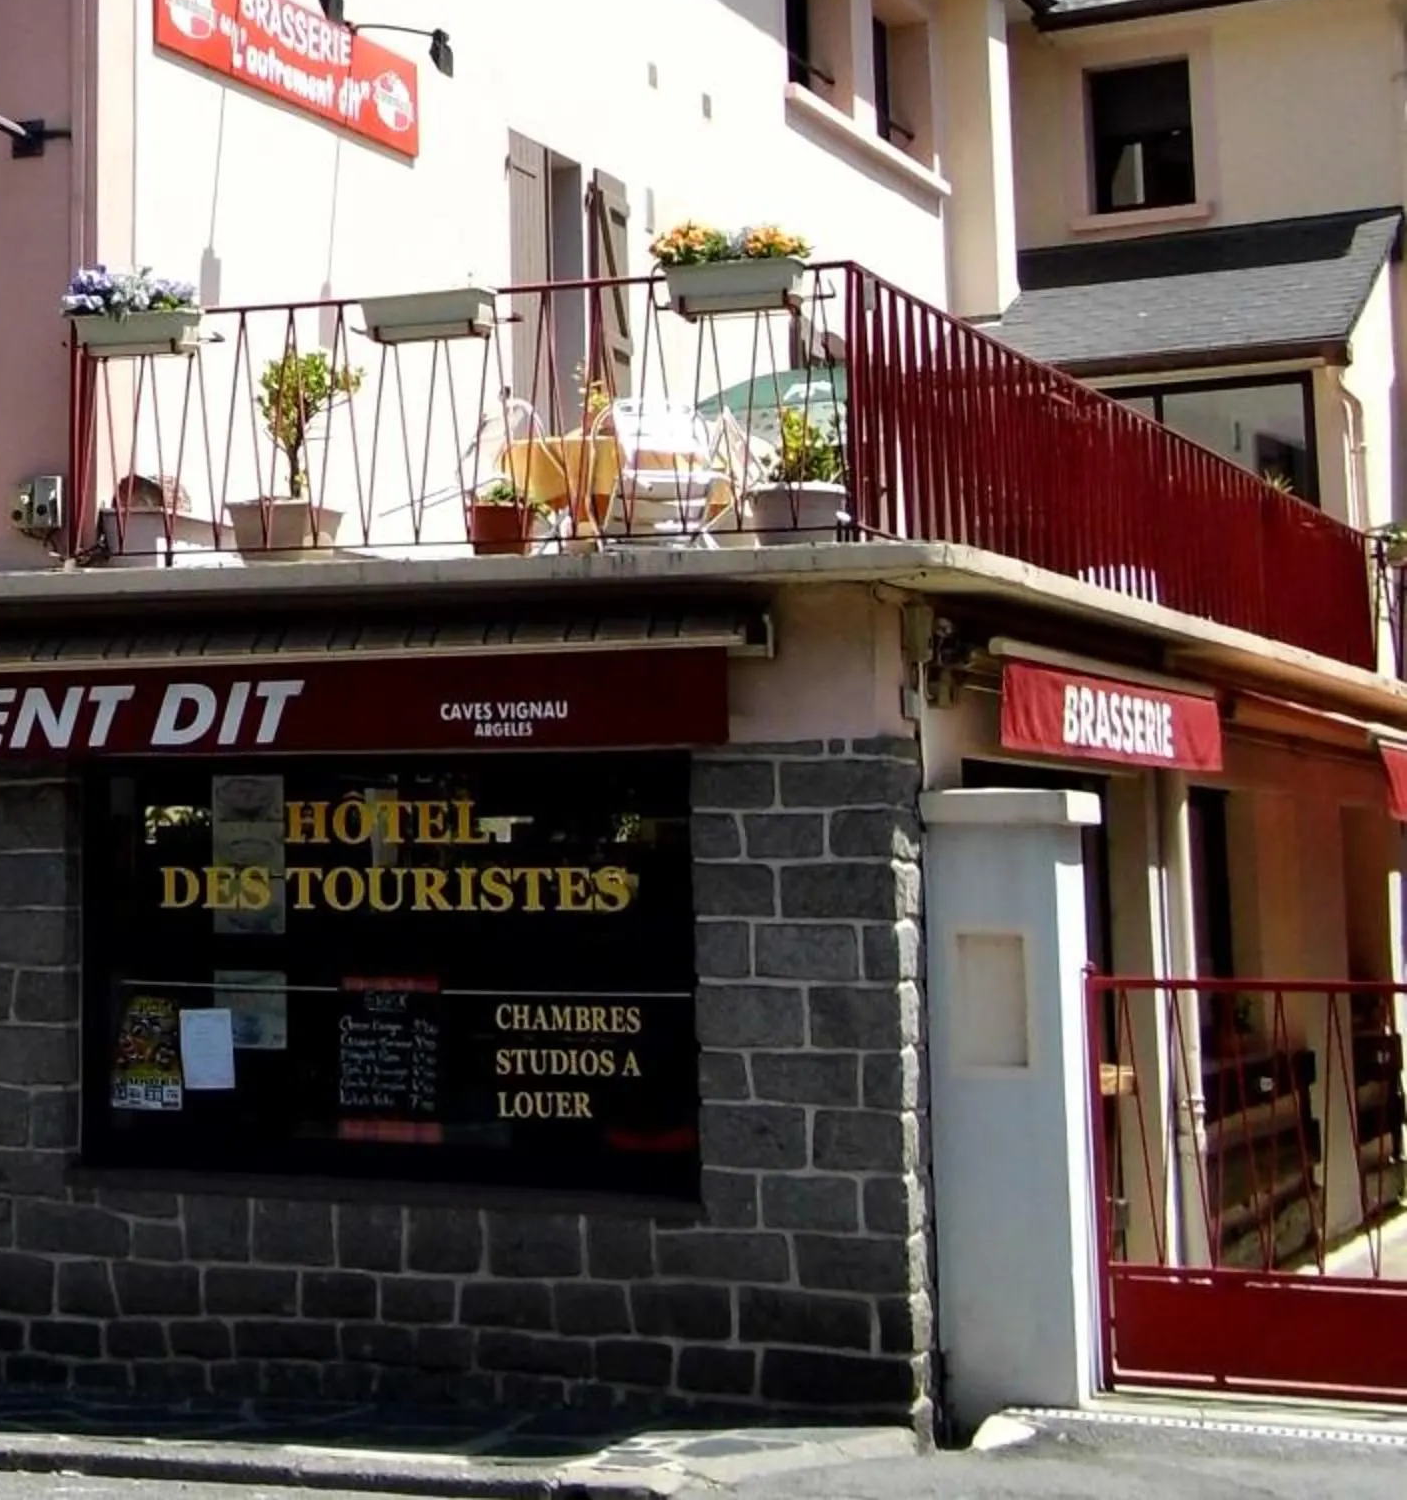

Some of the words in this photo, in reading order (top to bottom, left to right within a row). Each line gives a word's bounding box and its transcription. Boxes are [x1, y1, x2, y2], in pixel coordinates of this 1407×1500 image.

[150, 680, 305, 746] DIT
[440, 702, 493, 721] CAVES
[497, 700, 569, 719] VIGNAU
[1063, 684, 1175, 758] BRASSERIE
[474, 721, 534, 737] ARGELES
[284, 790, 490, 845] HÔTEL
[160, 866, 271, 910] DES
[285, 866, 632, 912] TOURISTES
[495, 1003, 642, 1034] CHAMBRES
[496, 1048, 615, 1077] STUDIOS
[622, 1050, 642, 1077] A
[498, 1091, 593, 1119] LOUER
